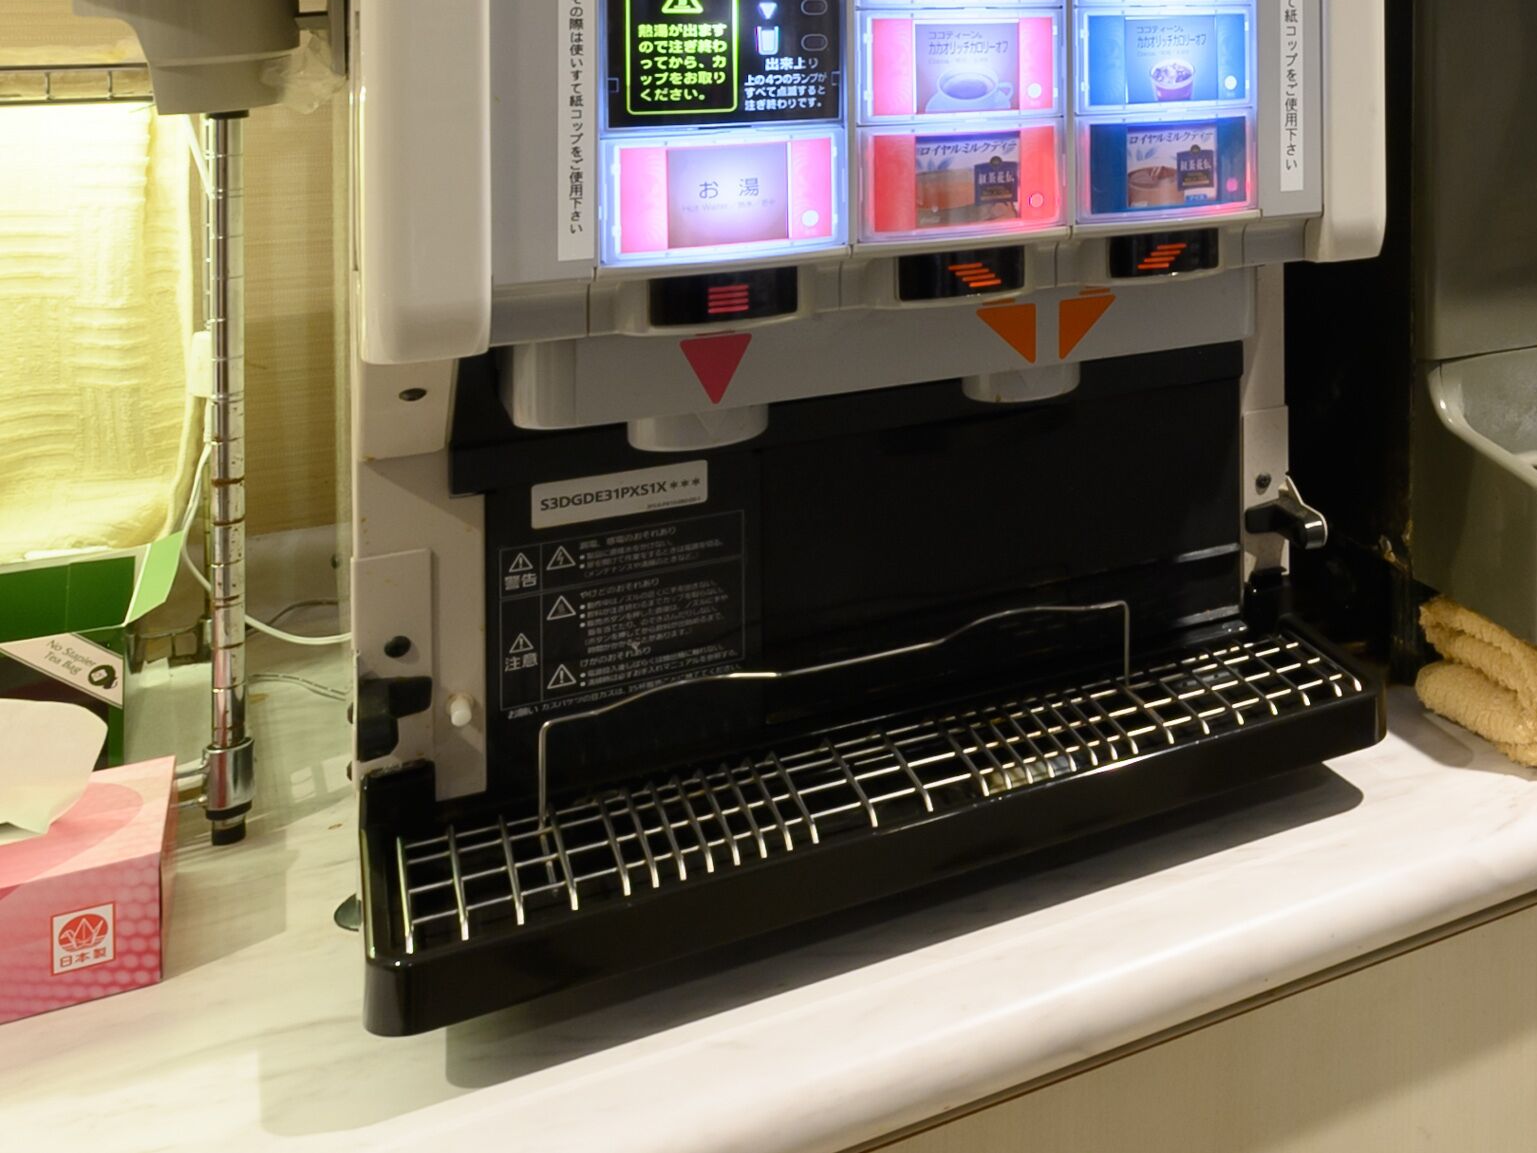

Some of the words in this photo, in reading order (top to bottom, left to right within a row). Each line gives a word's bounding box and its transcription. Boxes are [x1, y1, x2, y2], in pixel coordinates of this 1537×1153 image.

[638, 39, 727, 54] ので注ぎ終わ
[640, 88, 706, 102] ください。
[47, 640, 63, 651] No
[504, 653, 538, 672] 注意
